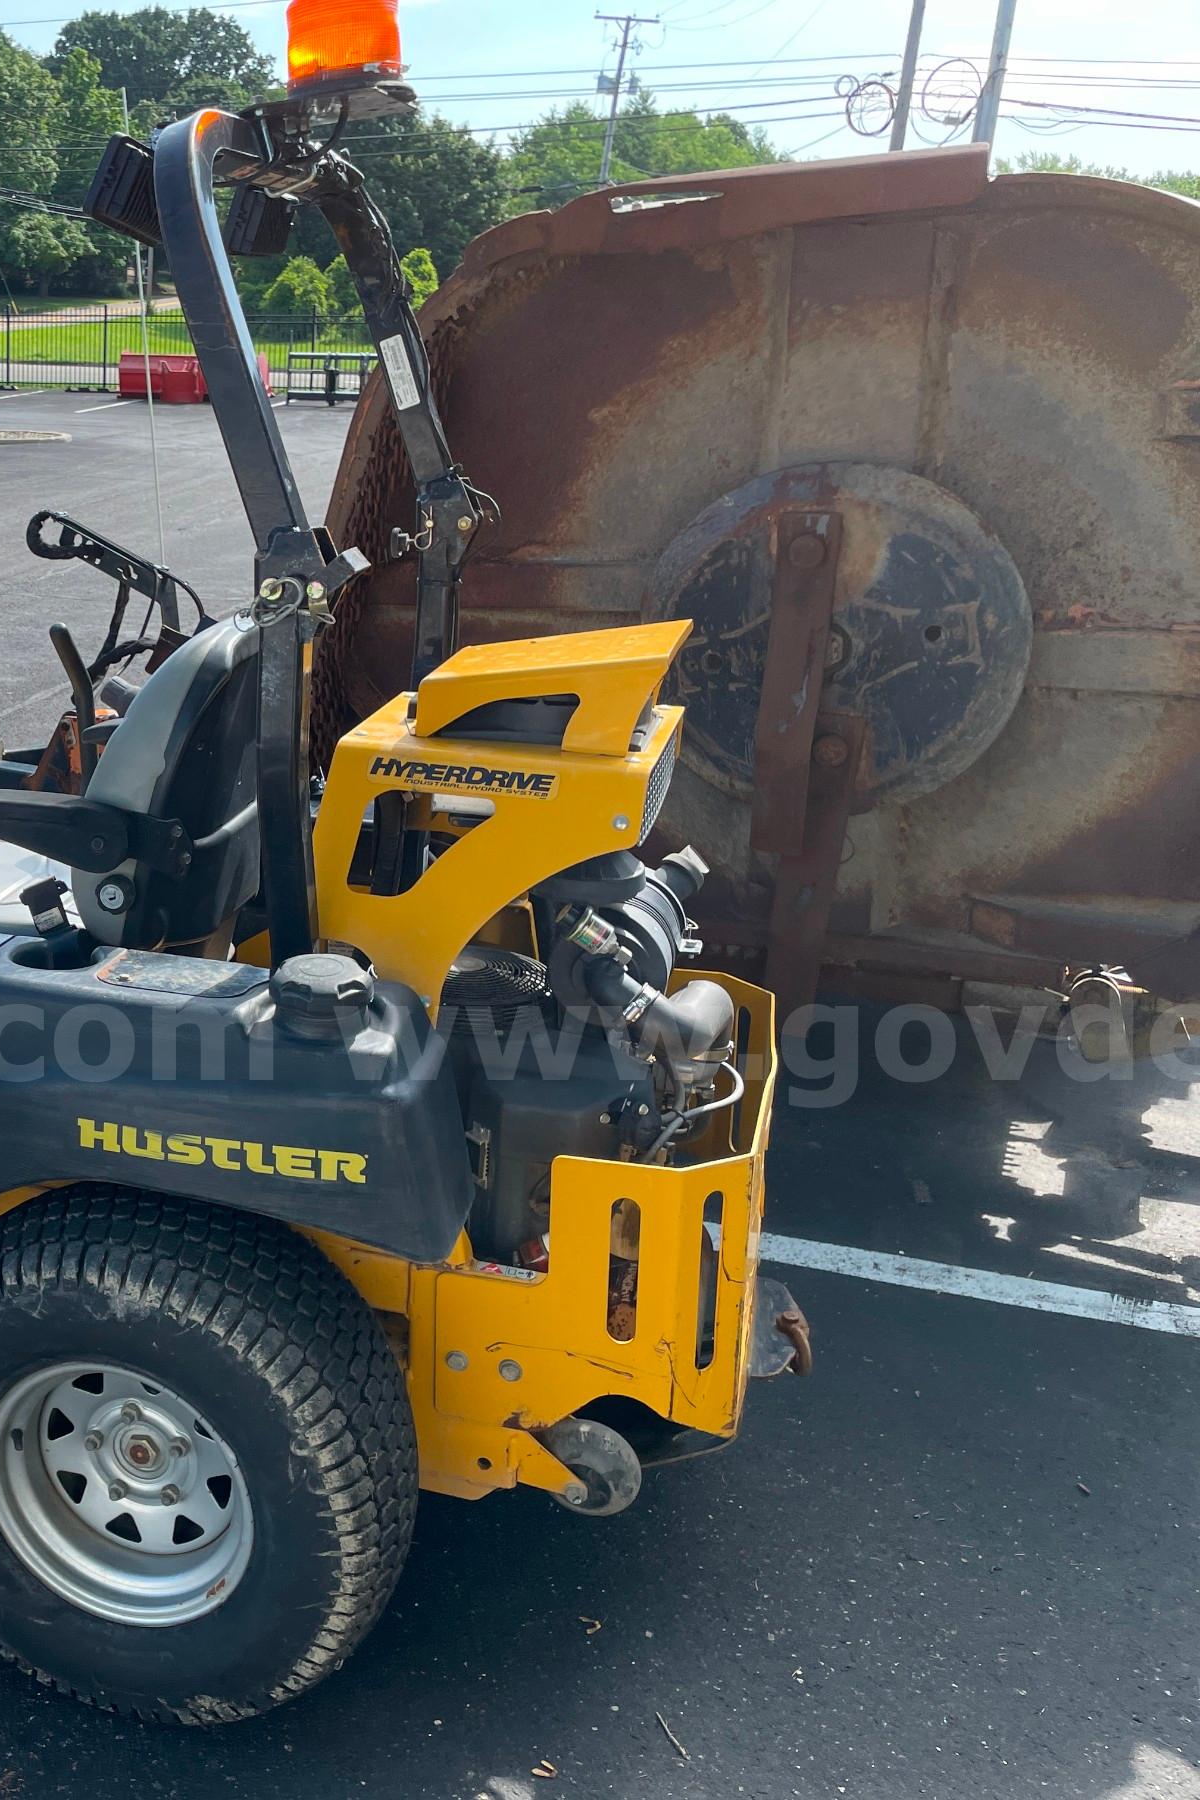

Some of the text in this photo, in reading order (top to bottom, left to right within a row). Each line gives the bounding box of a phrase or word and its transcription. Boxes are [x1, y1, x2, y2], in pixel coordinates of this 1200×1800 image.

[370, 757, 556, 792] HYPERDRIVE
[403, 778, 548, 798] INDUSTRIAL HYDRO SYSTEM
[77, 1117, 367, 1184] HUSTLER
